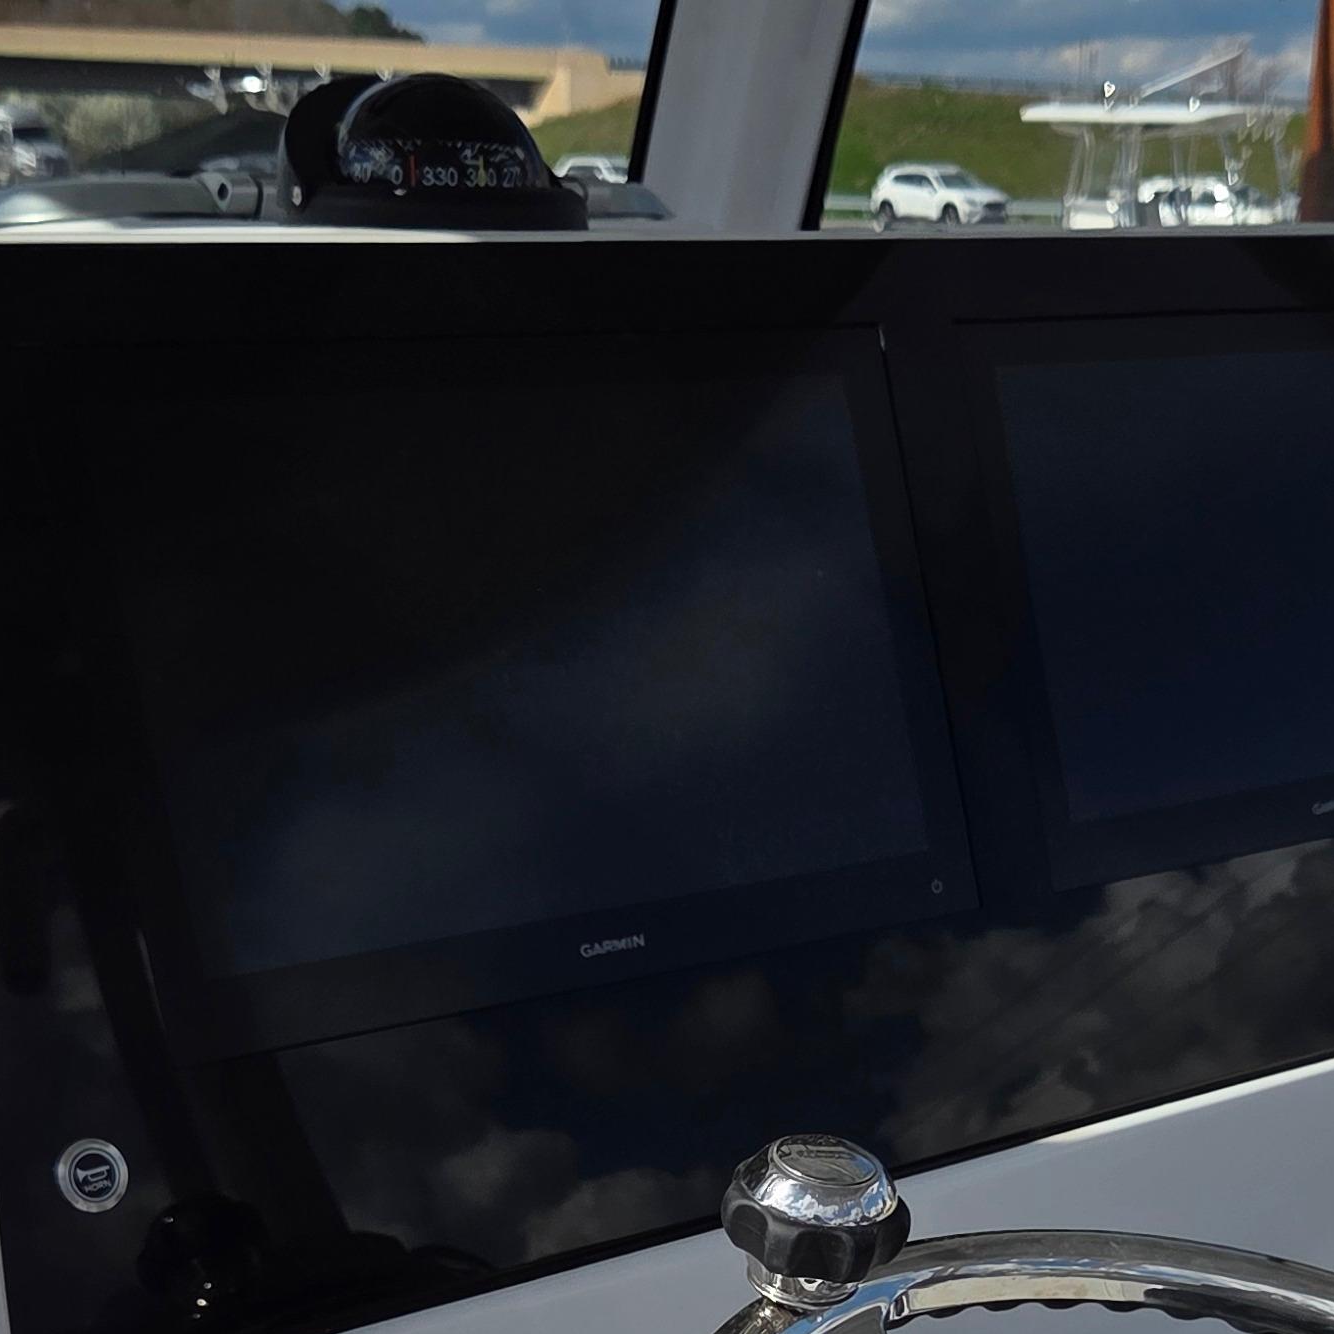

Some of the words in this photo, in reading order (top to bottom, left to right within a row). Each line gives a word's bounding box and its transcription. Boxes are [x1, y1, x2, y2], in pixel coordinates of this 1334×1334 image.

[422, 166, 458, 187] 330
[580, 934, 645, 958] GARMIN
[84, 1180, 112, 1193] HORN
